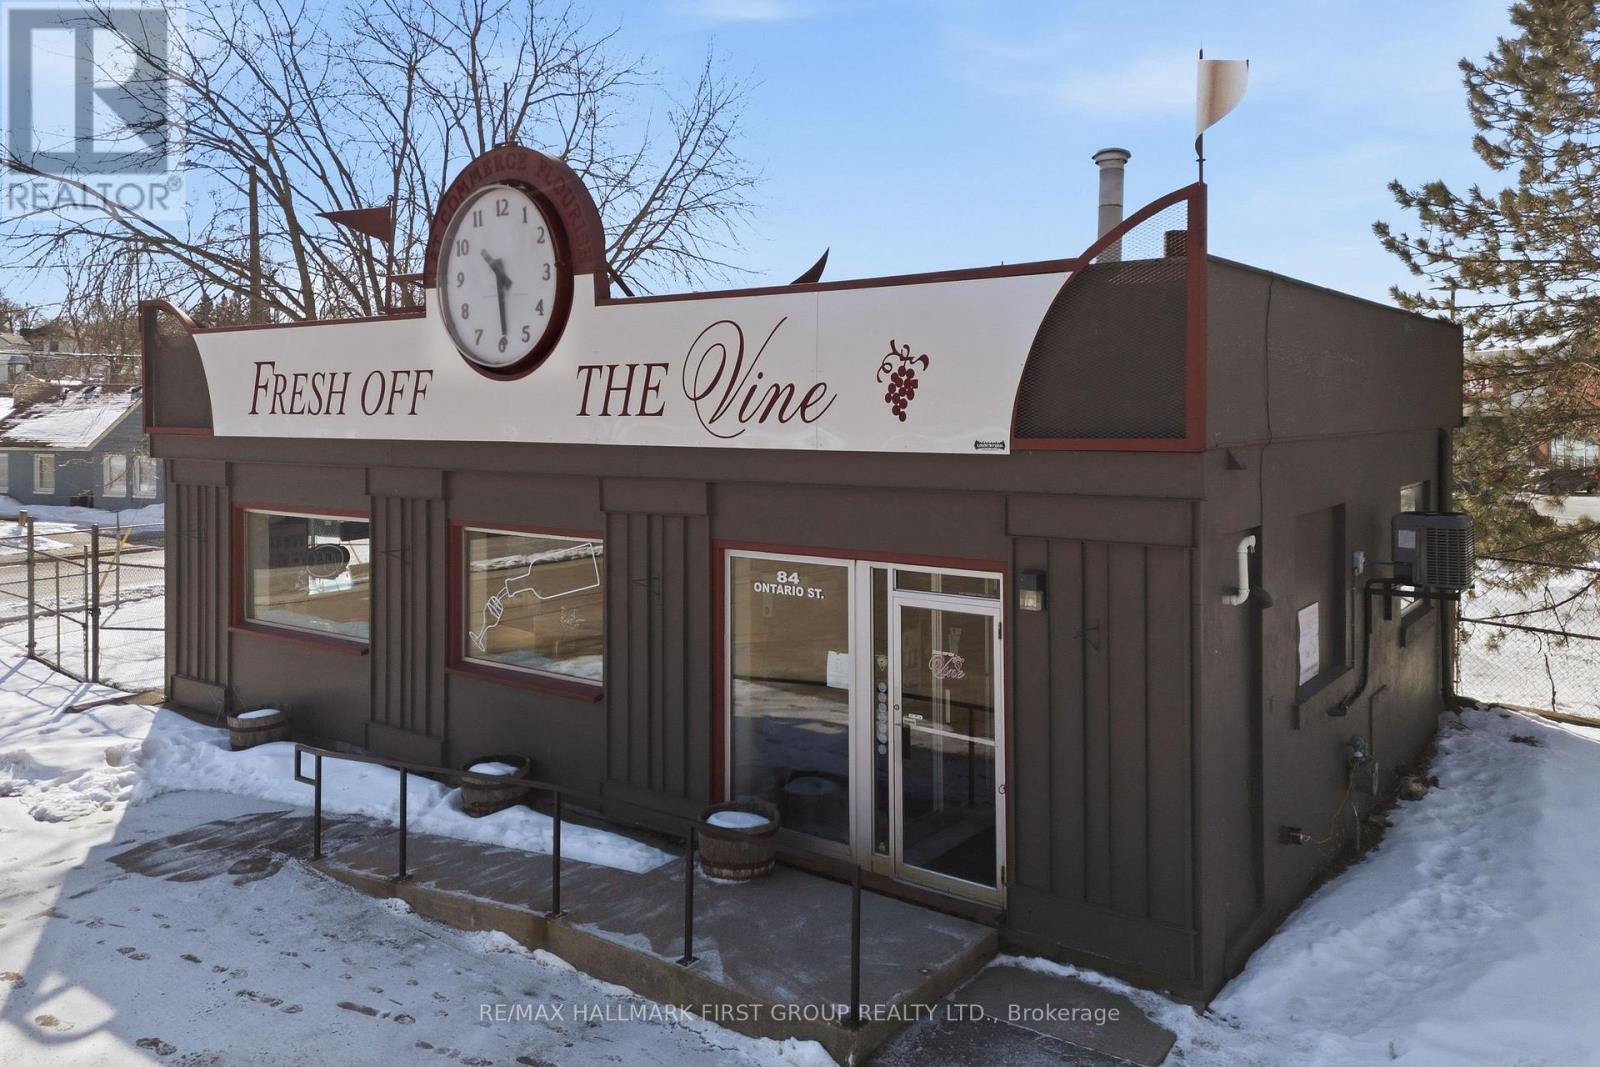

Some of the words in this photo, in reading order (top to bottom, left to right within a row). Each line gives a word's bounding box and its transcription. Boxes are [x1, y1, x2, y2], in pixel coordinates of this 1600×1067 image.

[495, 199, 509, 216] 12
[521, 206, 528, 223] 1
[472, 210, 483, 228] 11
[536, 226, 545, 244] 2
[456, 240, 469, 257] 10
[456, 271, 465, 288] 9
[542, 263, 551, 280] 3
[461, 303, 469, 320] 8
[535, 298, 544, 316] 4
[475, 328, 484, 345] 7
[521, 325, 531, 342] 5
[498, 335, 508, 353] 6
[248, 360, 352, 416] FRESH
[360, 369, 434, 416] OFF
[575, 362, 670, 418] THE
[682, 316, 837, 439] Vine
[776, 570, 800, 584] 84
[753, 582, 804, 598] ONTARIO
[807, 588, 825, 600] ST.
